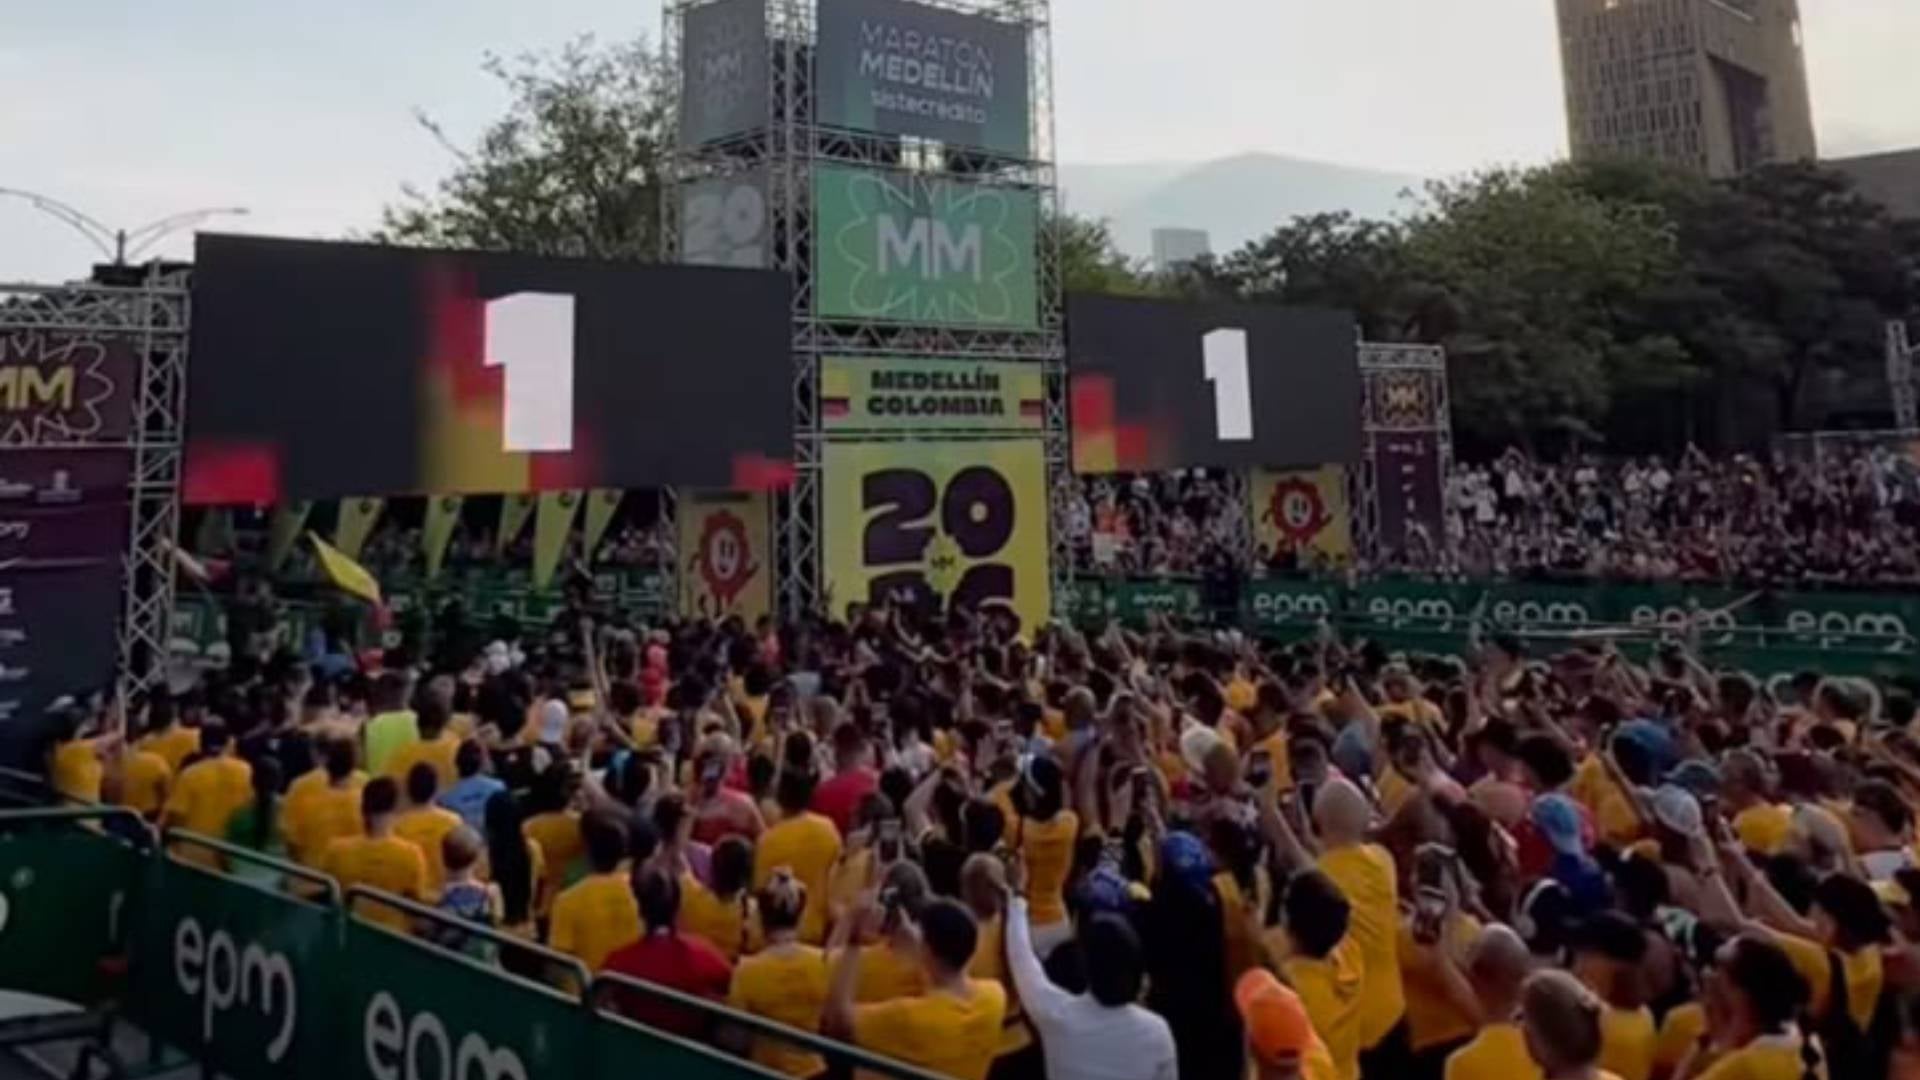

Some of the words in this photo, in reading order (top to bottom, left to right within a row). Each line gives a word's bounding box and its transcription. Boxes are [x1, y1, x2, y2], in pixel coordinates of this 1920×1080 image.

[859, 49, 995, 99] MEDELLÍN
[684, 184, 766, 254] 20
[875, 214, 982, 283] MM
[483, 291, 576, 452] 1
[871, 366, 1000, 391] MEDELLÍN
[1202, 327, 1254, 440] 1
[867, 396, 1004, 415] COLOMBIA
[862, 465, 1016, 567] 20
[1253, 592, 1331, 624] epm
[1370, 596, 1453, 632] epm
[1787, 609, 1907, 651] epm
[173, 915, 297, 1064] epm
